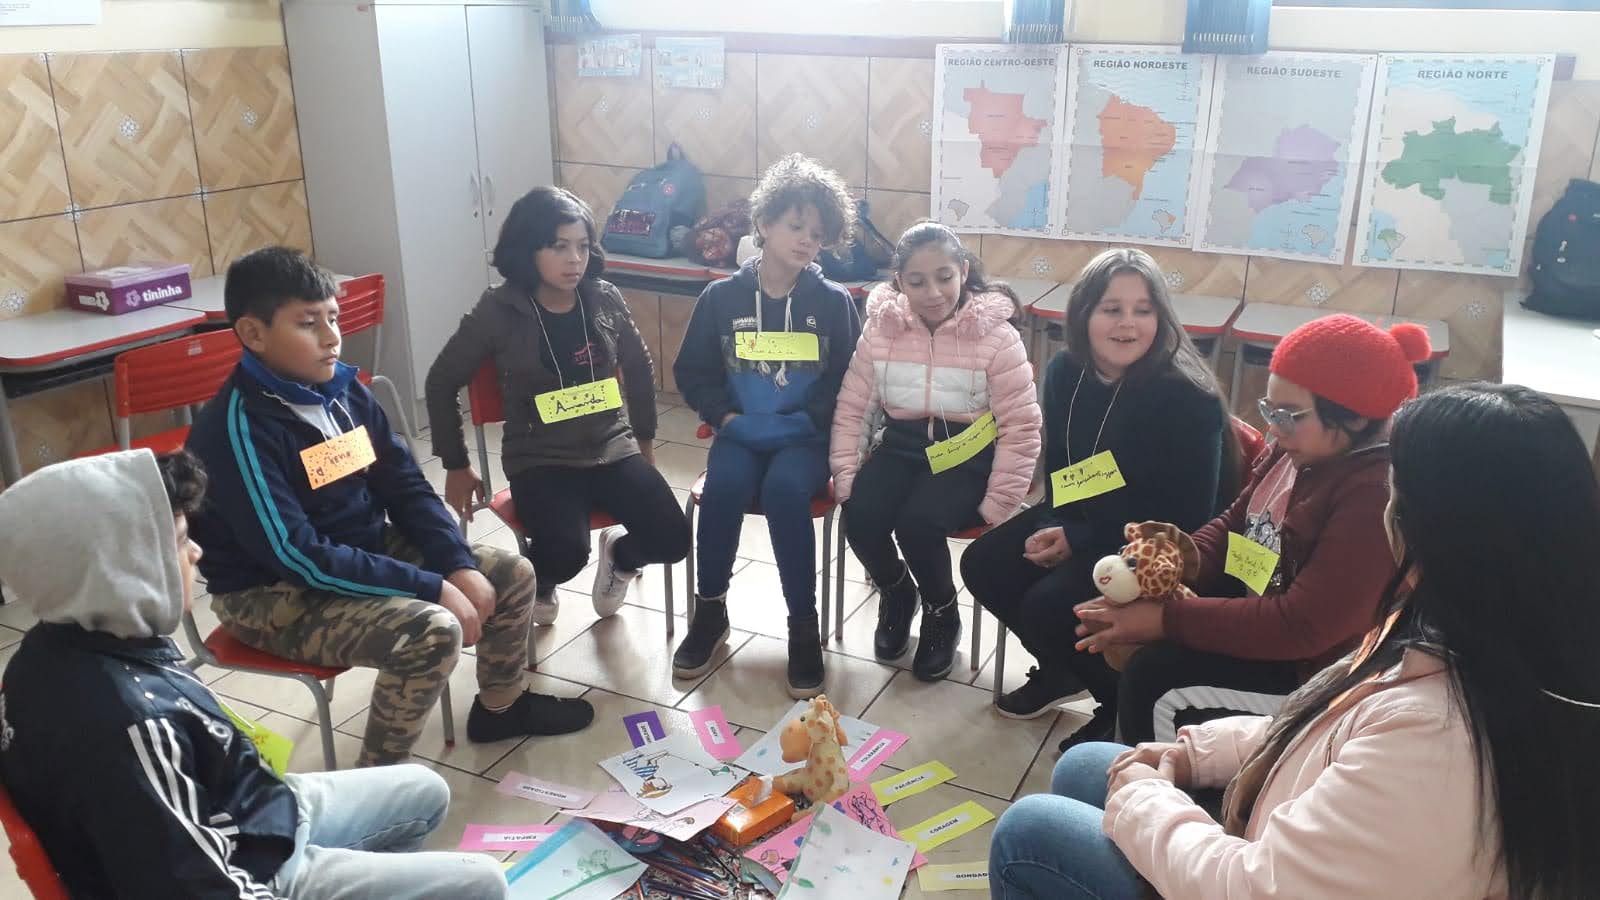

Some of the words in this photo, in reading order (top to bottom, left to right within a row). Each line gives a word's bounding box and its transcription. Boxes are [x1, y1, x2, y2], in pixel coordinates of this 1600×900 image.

[948, 56, 982, 66] REGIÃO
[984, 58, 1055, 66] CENTRO-OESTE
[1094, 58, 1131, 69] REGIÃO
[1133, 61, 1188, 70] NORDESTE
[1247, 65, 1288, 76] REGIÃO
[1290, 68, 1342, 78] SUDESTE
[1418, 68, 1463, 79] REGIÃO
[1466, 70, 1509, 80] NORTE
[142, 285, 183, 303] tininha
[895, 776, 924, 790] PACIÊNCIA
[930, 819, 958, 834] CORAGEM
